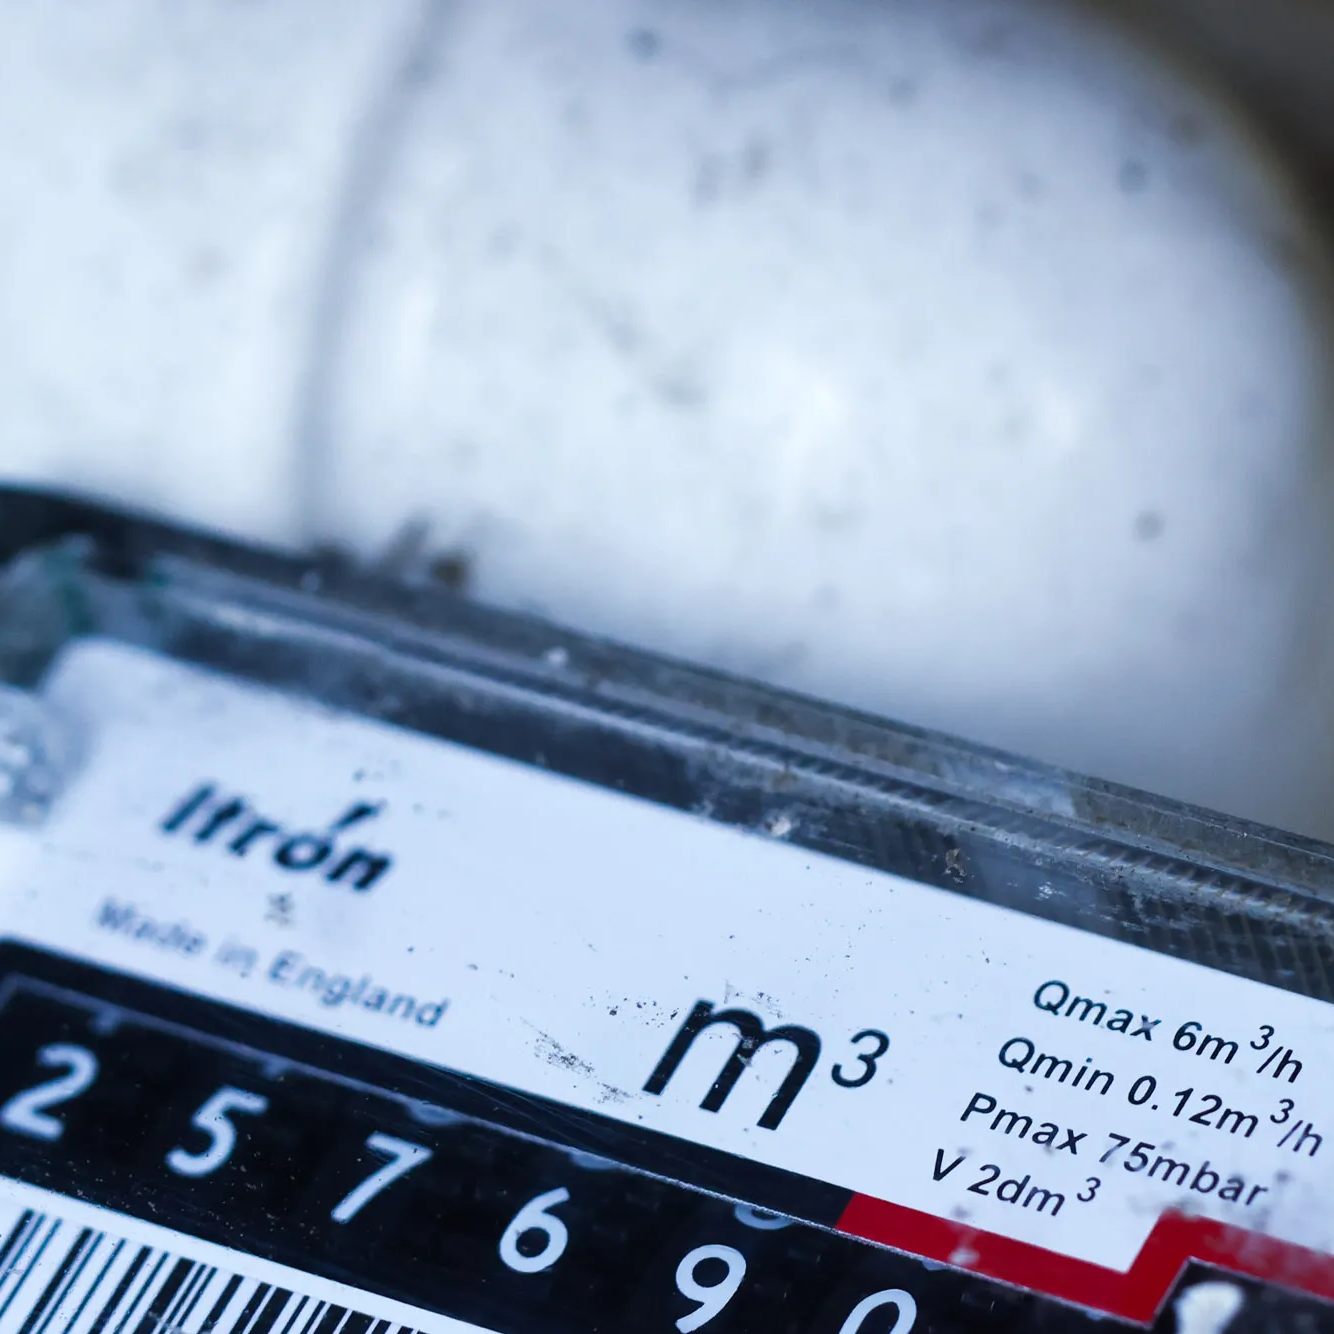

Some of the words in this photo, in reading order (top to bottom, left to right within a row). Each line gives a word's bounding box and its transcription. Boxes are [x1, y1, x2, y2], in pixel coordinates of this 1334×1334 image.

[95, 898, 205, 956] Made
[216, 934, 259, 979] in
[267, 949, 450, 1029] England
[1034, 979, 1162, 1042] Qmax
[998, 1036, 1115, 1096] Qmin
[930, 1148, 963, 1183] V
[960, 1092, 1088, 1155] Pmax
[1099, 1132, 1269, 1208] 75mbar
